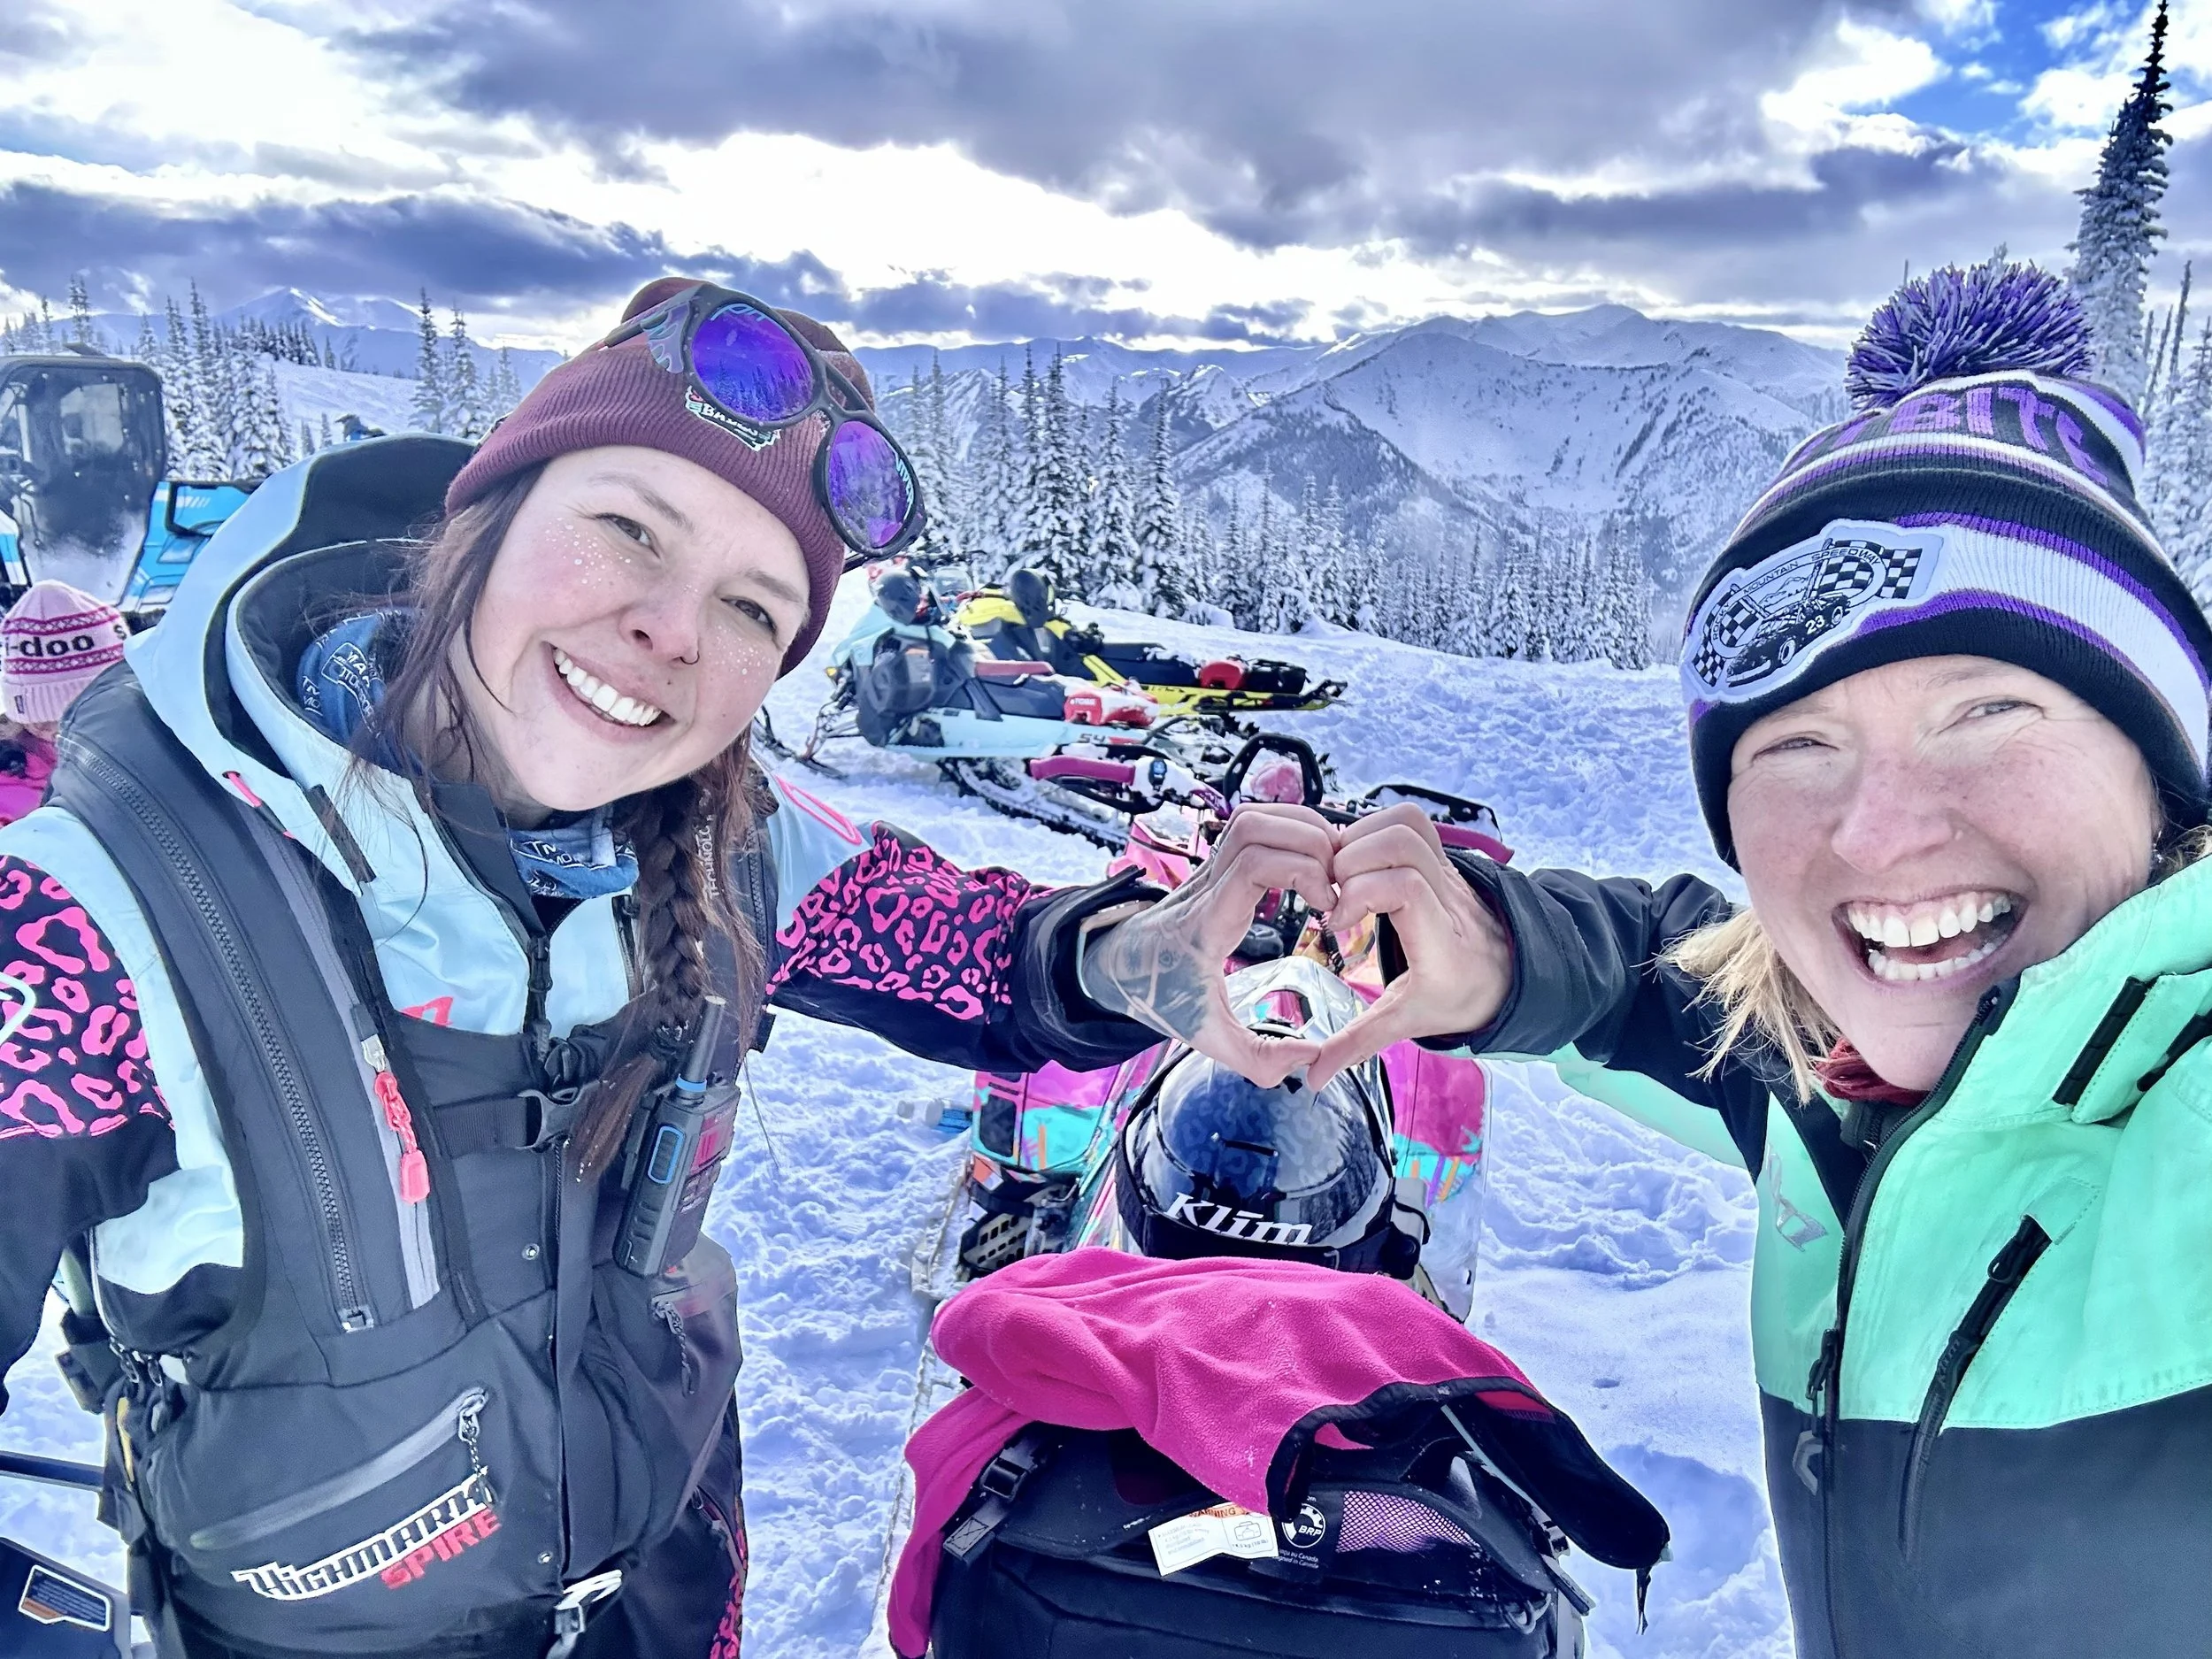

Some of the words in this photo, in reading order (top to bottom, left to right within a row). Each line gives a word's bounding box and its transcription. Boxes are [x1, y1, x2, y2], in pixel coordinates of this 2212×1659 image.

[1712, 603, 1729, 641] ROCKY
[1743, 561, 1799, 595] MOUNTAIN
[1811, 547, 1881, 565] SPEEDWAY
[1805, 615, 1825, 634] 23
[1298, 1525, 1323, 1537] BRP
[380, 1508, 502, 1590] SPIRE
[1298, 1552, 1319, 1563] Canada
[1298, 1559, 1319, 1569] Canada
